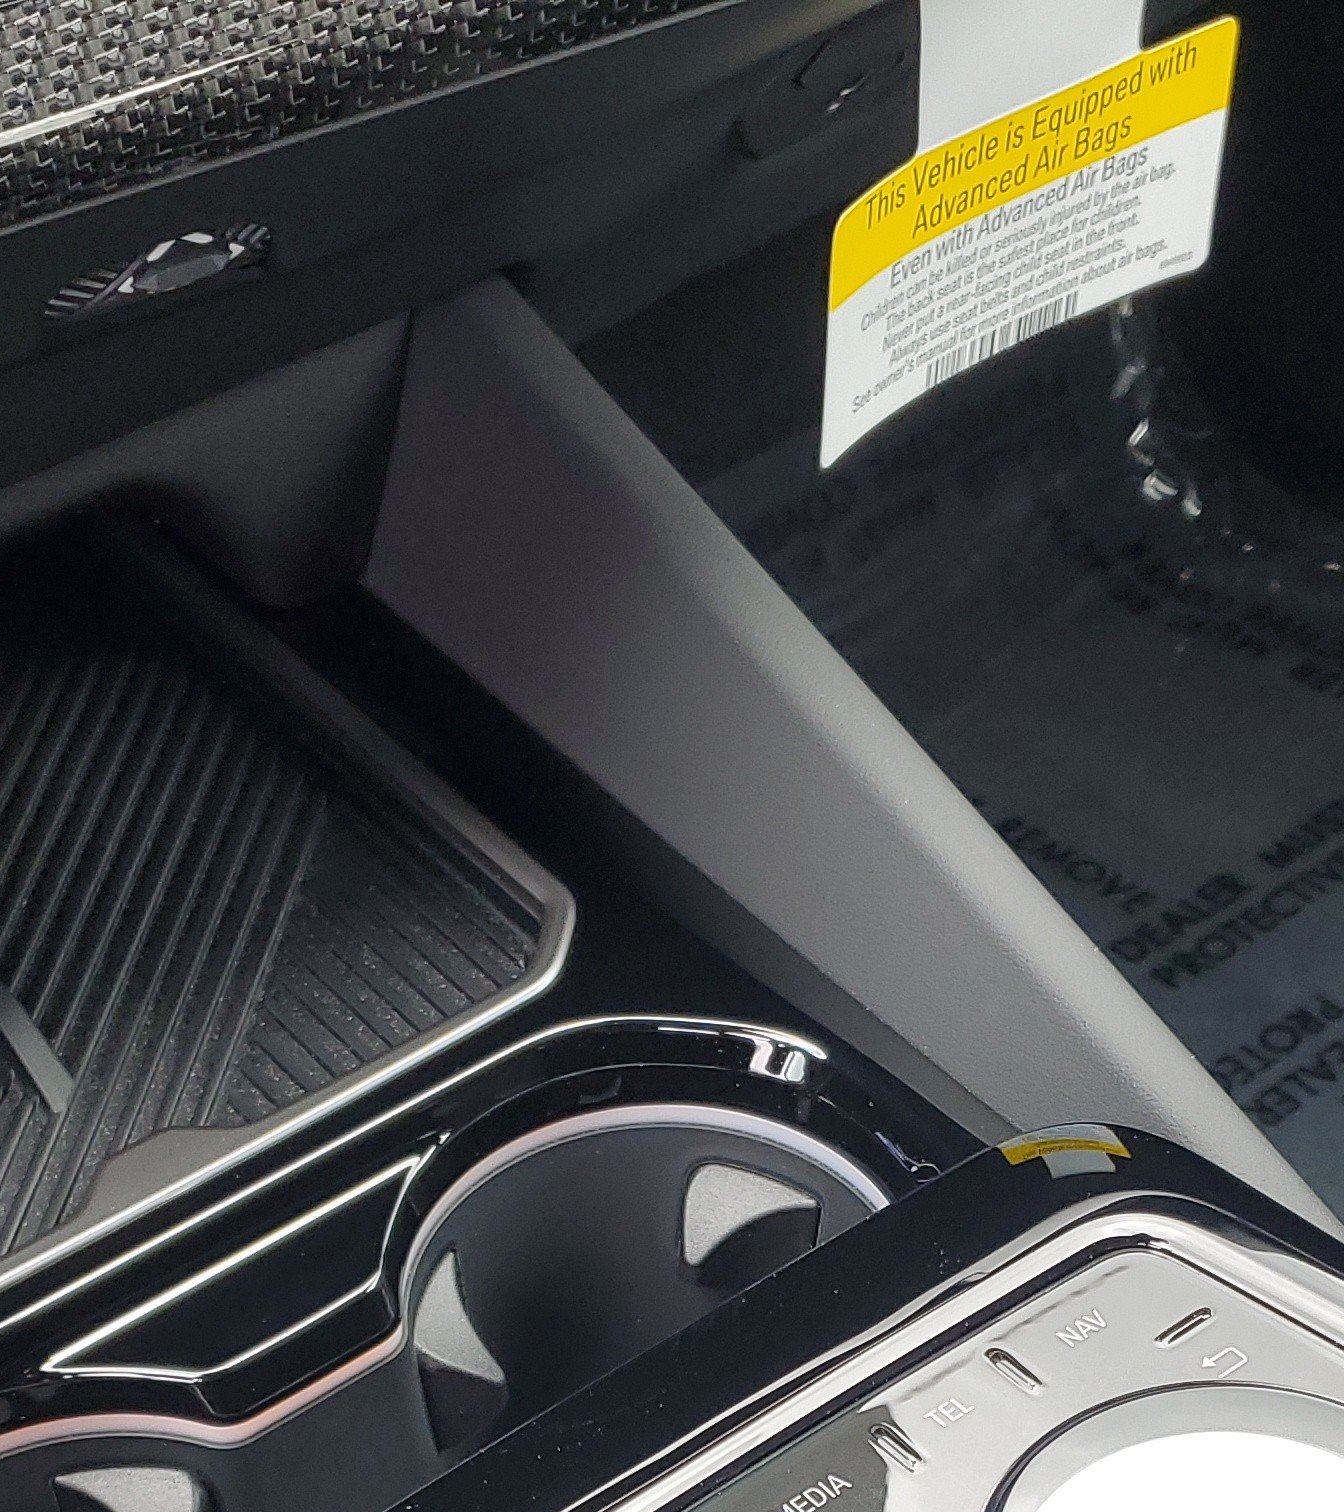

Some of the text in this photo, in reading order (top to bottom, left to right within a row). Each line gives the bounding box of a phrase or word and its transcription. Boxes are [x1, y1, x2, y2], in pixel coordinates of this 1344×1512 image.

[865, 40, 1197, 230] This Vehicle is Equipped with
[912, 115, 1132, 240] Advanced Air Bags
[890, 146, 1149, 289] Even with Advanced Air Bags
[994, 216, 1047, 253] seriously
[1044, 240, 1071, 261] seat
[936, 274, 963, 300] seat
[953, 302, 979, 328] seat
[1055, 1309, 1109, 1348] NAV
[924, 1397, 975, 1430] TEL
